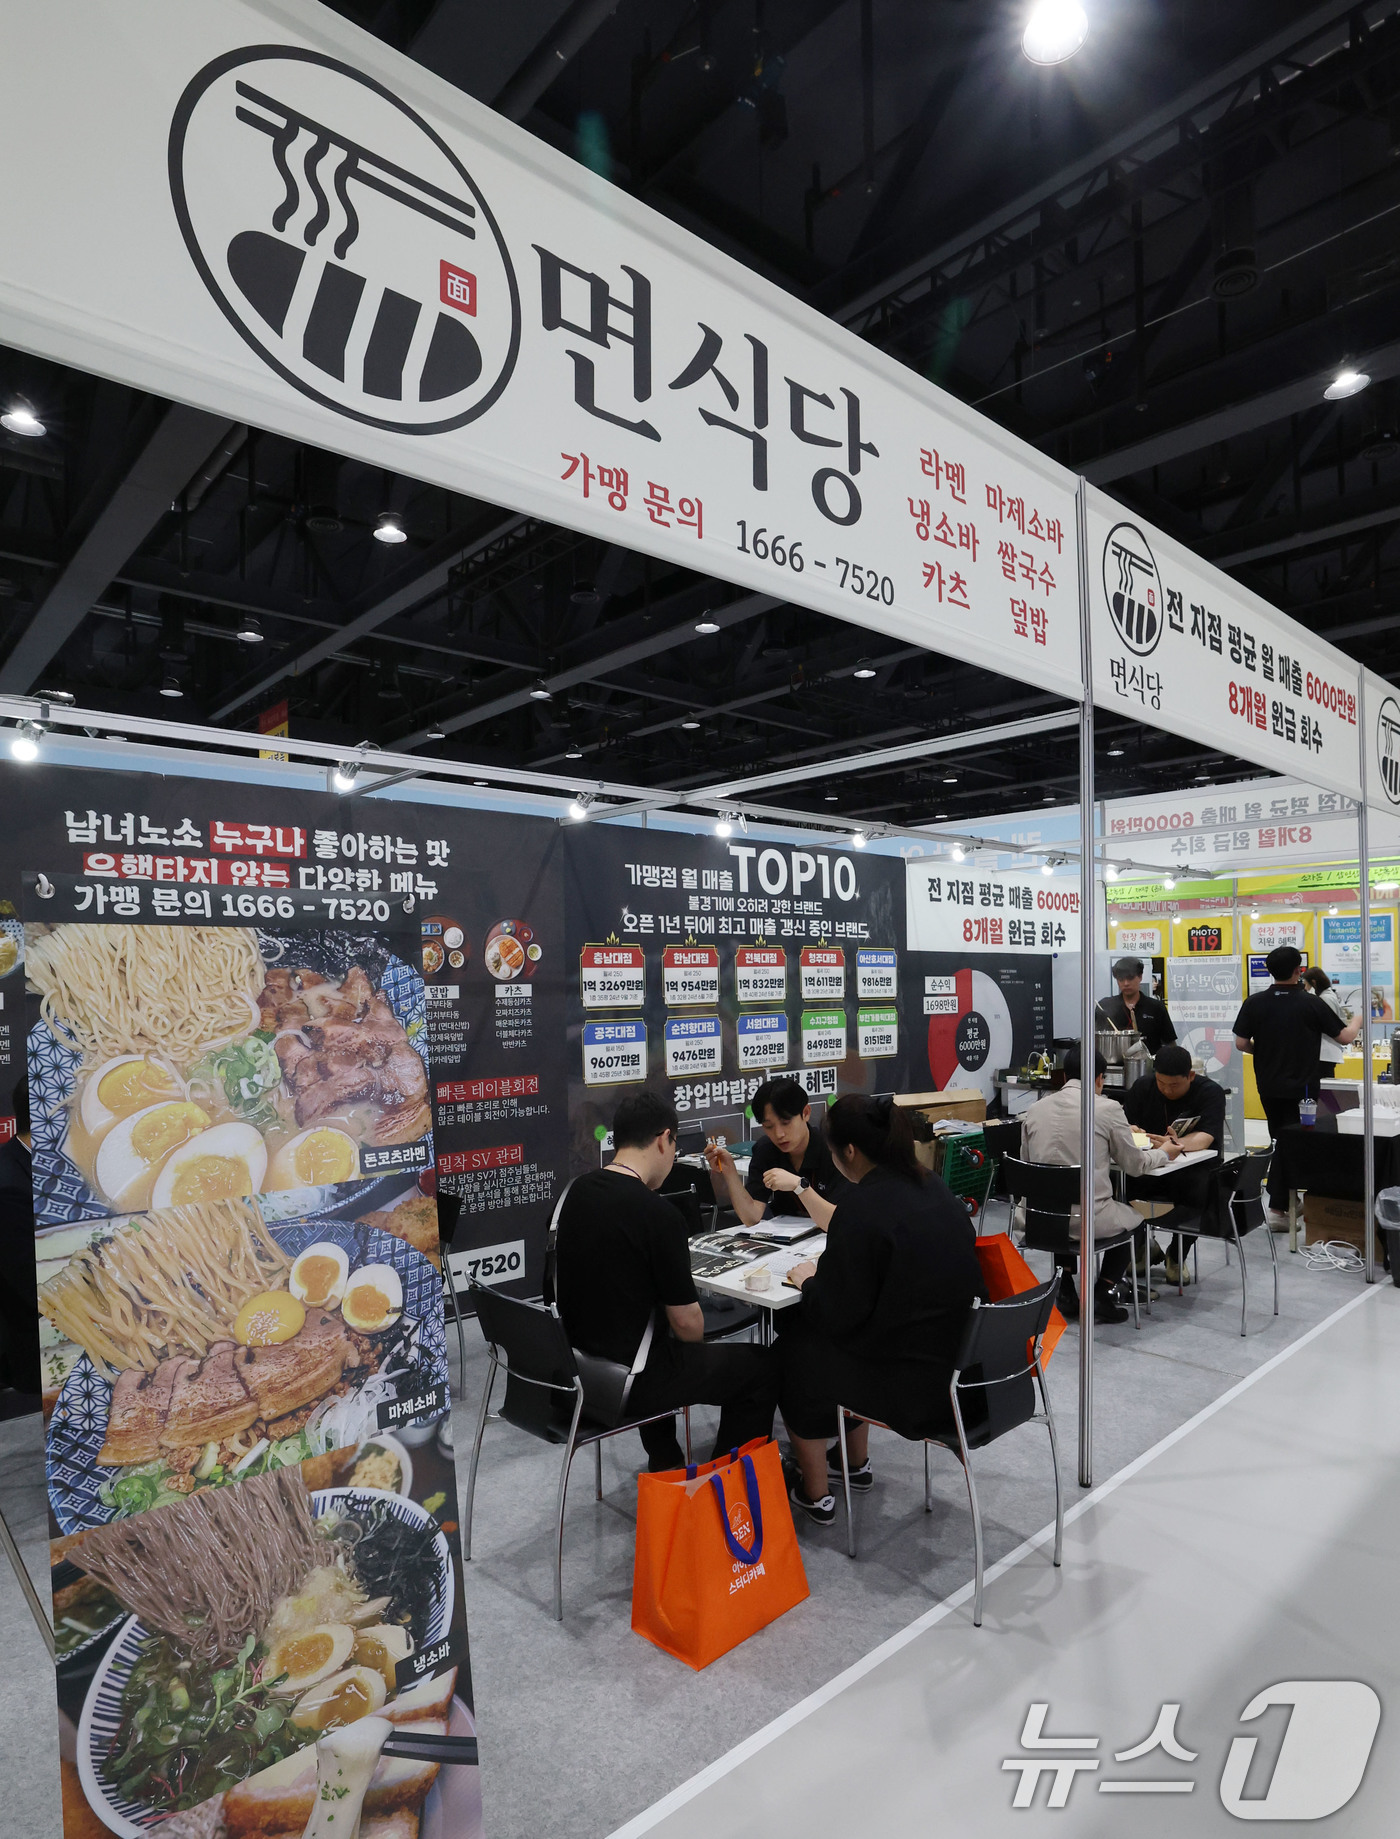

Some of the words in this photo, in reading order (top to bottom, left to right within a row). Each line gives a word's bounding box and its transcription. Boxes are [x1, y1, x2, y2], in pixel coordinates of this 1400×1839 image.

[531, 243, 880, 527] 면식당
[560, 452, 628, 511] 가맹
[643, 480, 703, 539] 문의
[919, 448, 967, 505] 라멘
[985, 484, 1064, 554] 마제소바
[907, 497, 980, 562] 냉소바
[997, 540, 1056, 597] 쌀국수
[736, 520, 804, 573] 1666
[835, 557, 895, 606] 7520
[922, 561, 970, 610] 카츠
[1010, 597, 1049, 646] 덮밥
[1167, 587, 1184, 634] 전
[1190, 603, 1222, 655] 지점
[1228, 623, 1257, 672] 평균
[1262, 643, 1275, 682] 월
[1278, 654, 1303, 697] 매출
[1306, 671, 1357, 725] 6000만원
[1110, 657, 1163, 710] 면식당
[1229, 681, 1267, 731] 8개월
[1272, 700, 1296, 743] 원금
[1300, 715, 1323, 754] 회수
[64, 810, 203, 848] 남녀노소
[213, 821, 305, 857] 누구나
[312, 829, 419, 865] 좋아하는
[425, 839, 450, 867] 맛
[624, 863, 677, 888] 가맹점
[681, 868, 698, 889] 월
[702, 870, 733, 891] 매출
[729, 845, 856, 901] TOP10
[390, 871, 438, 900] 메뉴
[74, 884, 140, 915] 가맹
[152, 888, 212, 918] 문의
[221, 893, 295, 918] 1666
[321, 897, 390, 921] 7520
[928, 877, 942, 903] 전
[947, 880, 974, 906] 지점
[979, 882, 1004, 908] 평균
[1009, 886, 1033, 910] 매출
[1037, 890, 1080, 914] 6000만
[688, 895, 734, 912] 불경기에
[737, 898, 768, 913] 오히려
[771, 900, 791, 915] 강한
[794, 901, 823, 916] 브랜드
[623, 914, 654, 934] 오픈
[658, 915, 680, 934] 1년
[684, 916, 715, 934] 뒤에
[719, 917, 746, 935] 최고
[749, 917, 776, 935] 매출
[780, 918, 805, 936] 갱신
[809, 920, 832, 937] 중인
[835, 921, 868, 939] 브랜드
[963, 917, 1003, 945] 8개월
[1009, 919, 1036, 946] 원금
[1041, 921, 1066, 947] 회수
[1191, 936, 1218, 951] 119
[1258, 937, 1275, 946] 지원
[593, 952, 632, 965] 충남대점
[673, 952, 709, 965] 한남대점
[745, 952, 777, 964] 전북대점
[583, 981, 597, 992] 1억
[600, 980, 643, 991] 3269만원
[666, 981, 679, 992] 1억
[681, 980, 717, 991] 954만원
[739, 979, 750, 989] 1억
[752, 978, 784, 989] 832만원
[804, 977, 815, 987] 1억
[816, 976, 842, 987] 611만원
[862, 977, 892, 987] 9816만원
[931, 979, 951, 991] 순수익
[430, 987, 449, 999] 덮밥
[505, 985, 523, 996] 카츠
[926, 999, 957, 1011] 1698만원
[671, 1021, 715, 1036] 순천향대점
[746, 1018, 778, 1030] 서원대점
[594, 1026, 636, 1040] 공주대점
[864, 1034, 892, 1045] 8151만원
[967, 1027, 980, 1039] 평균
[502, 1040, 527, 1049] 반반카츠
[743, 1043, 784, 1057] 9228만원
[807, 1038, 842, 1050] 8498만원
[959, 1039, 986, 1051] 6000만원
[591, 1054, 640, 1069] 9607만원
[672, 1048, 715, 1062] 9476만원
[437, 1085, 467, 1101] 빠른
[471, 1077, 539, 1099] 테이블회전
[806, 1069, 834, 1093] 혜택
[438, 1104, 455, 1116] 쉽고
[457, 1103, 474, 1113] 빠른
[476, 1101, 500, 1110] 조리로
[502, 1098, 518, 1108] 인해
[438, 1115, 455, 1126] 많은
[457, 1113, 482, 1124] 테이블
[484, 1110, 508, 1120] 회전이
[364, 1146, 426, 1168] 돈코츠라멘
[438, 1154, 467, 1173] 밀착
[472, 1151, 491, 1168] SV
[496, 1146, 522, 1164] 관리
[458, 1173, 475, 1184] 담당
[468, 1252, 520, 1279] 7520
[388, 1390, 437, 1420] 마제소바
[729, 1563, 766, 1595] 스터디카페
[413, 1641, 450, 1673] 냉소바
